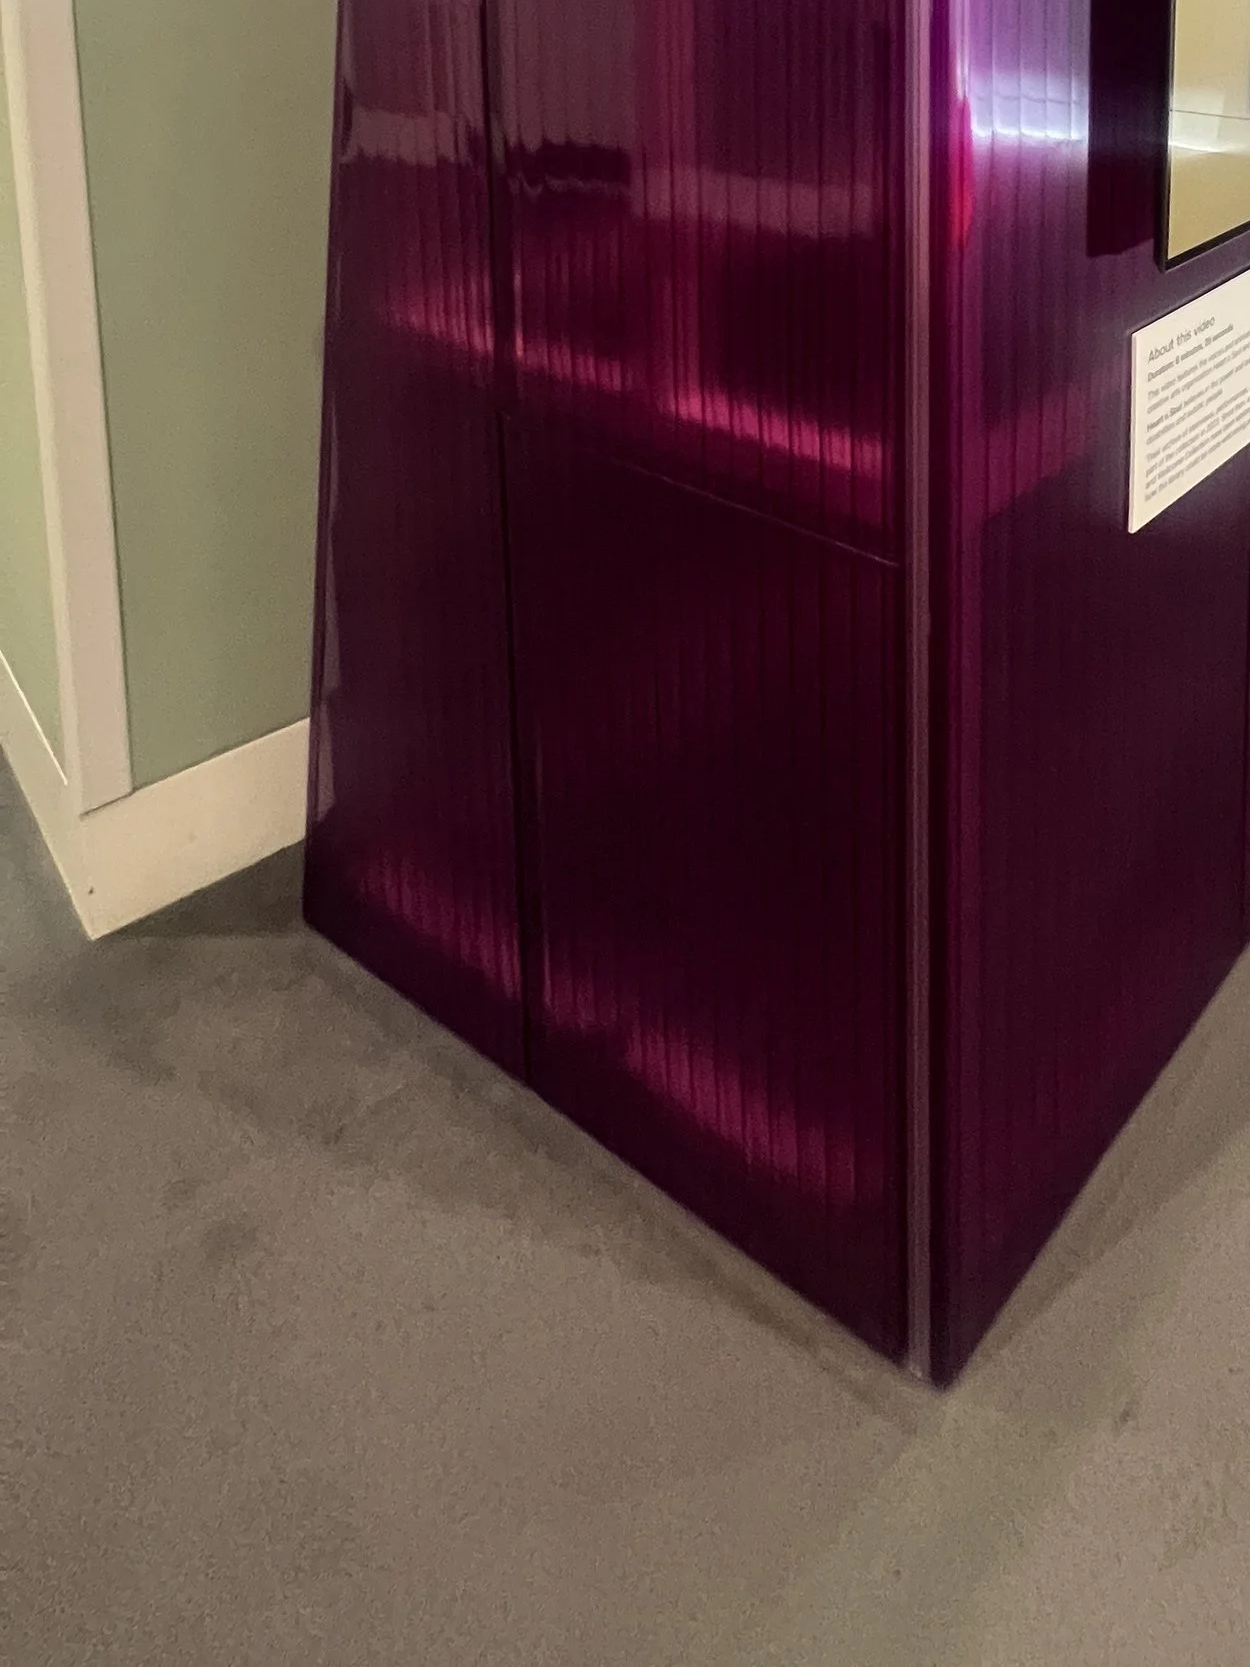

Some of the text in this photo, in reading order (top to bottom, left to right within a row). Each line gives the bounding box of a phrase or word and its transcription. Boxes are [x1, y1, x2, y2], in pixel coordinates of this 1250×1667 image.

[1148, 316, 1216, 364] About this video
